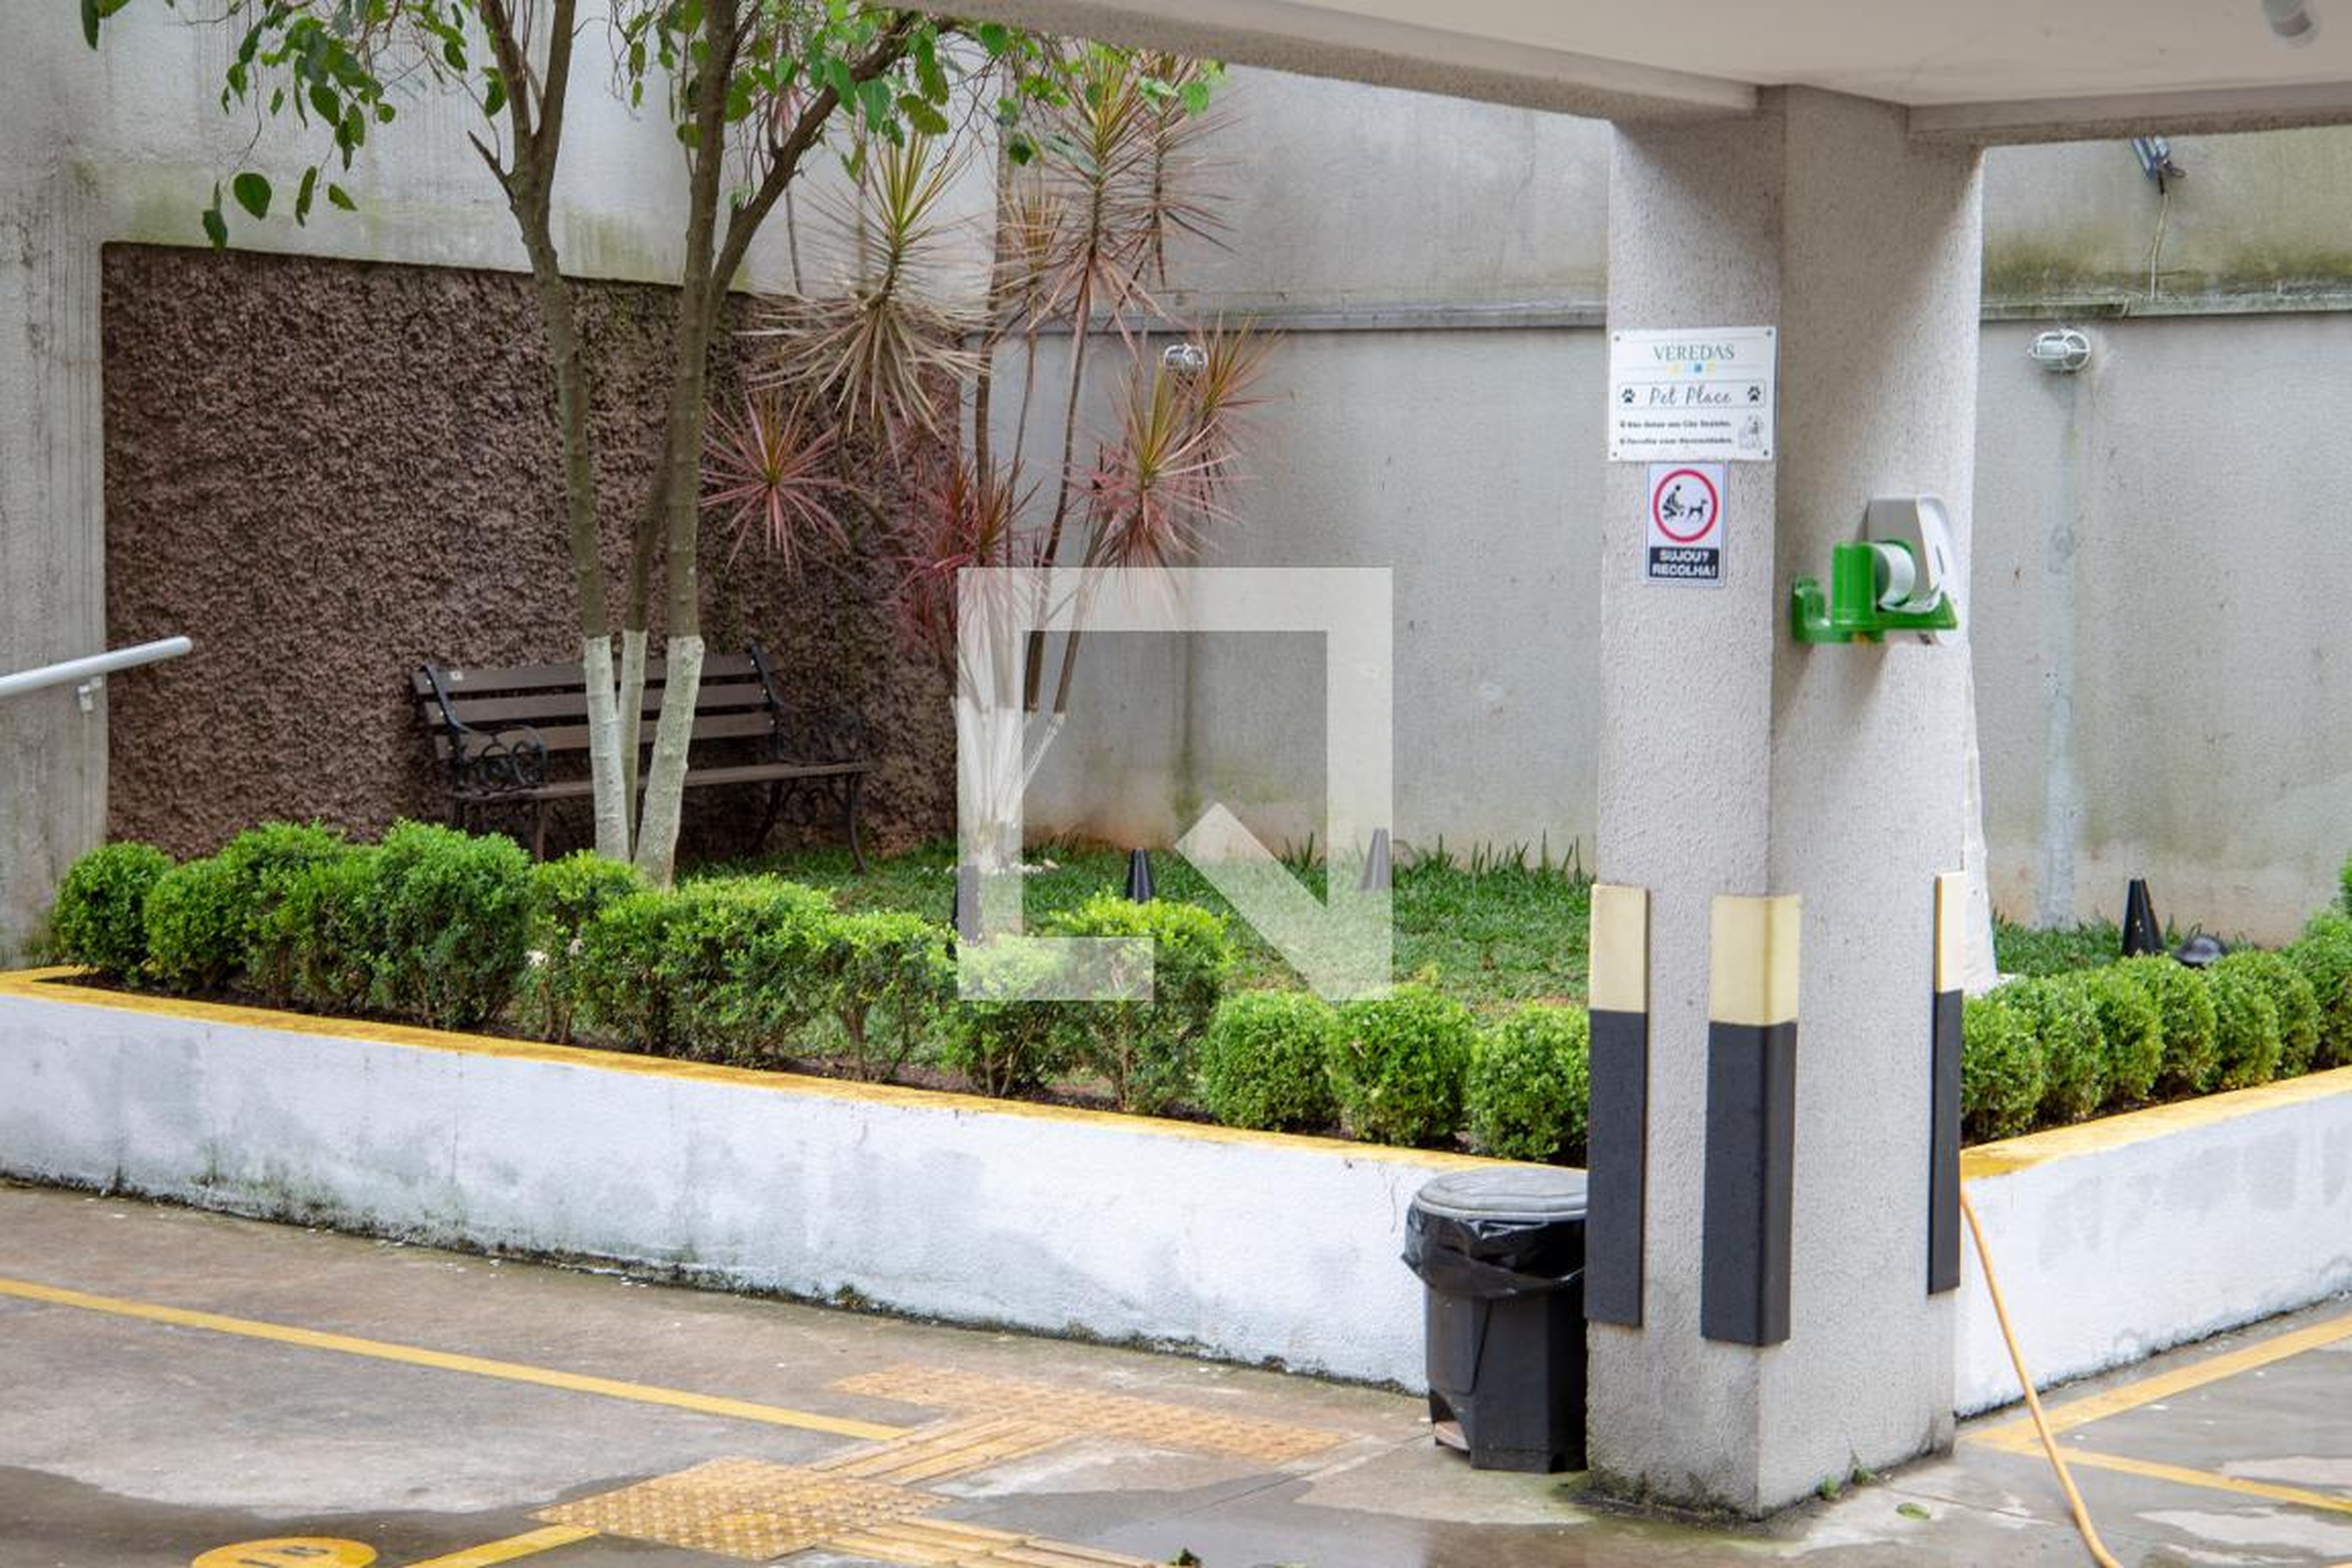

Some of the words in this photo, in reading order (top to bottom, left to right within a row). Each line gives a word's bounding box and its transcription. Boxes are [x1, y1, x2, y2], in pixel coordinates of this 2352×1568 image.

[1654, 344, 1735, 360] VEREDAS
[1649, 386, 1676, 405] Pet
[1686, 385, 1732, 405] Place
[1659, 549, 1709, 563] SUJOU?
[1652, 563, 1716, 577] RECOLHA!
